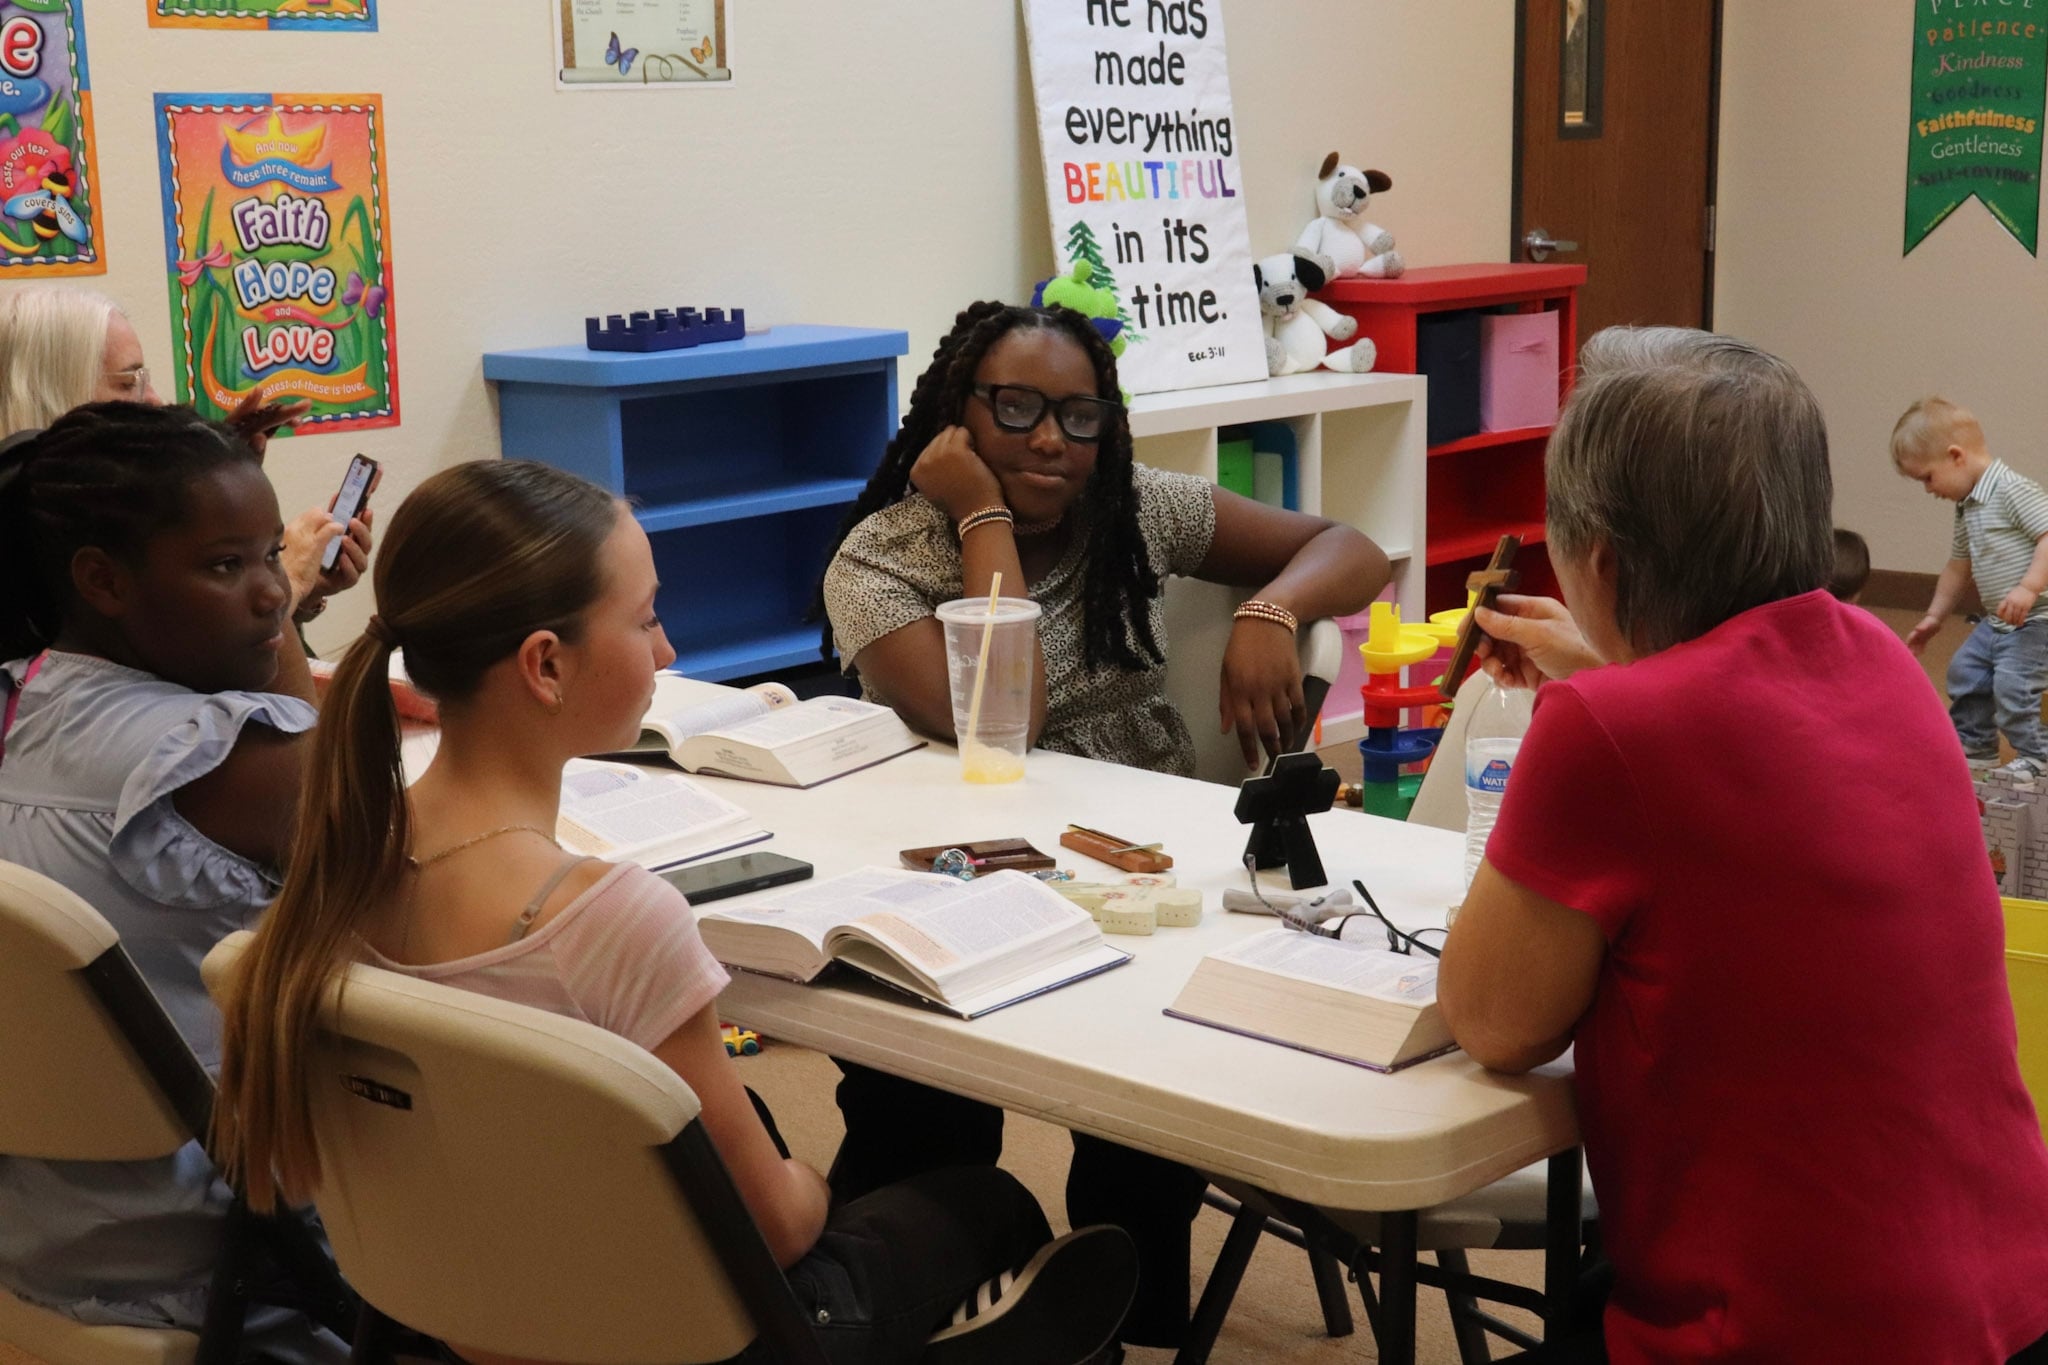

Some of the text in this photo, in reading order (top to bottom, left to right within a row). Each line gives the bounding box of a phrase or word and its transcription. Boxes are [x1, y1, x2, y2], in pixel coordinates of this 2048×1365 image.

[1086, 0, 1208, 39] He has
[1095, 41, 1186, 86] made
[1931, 51, 2024, 76] Kindness
[1065, 105, 1232, 157] everything
[1916, 109, 2036, 138] Faithfulness
[4, 142, 49, 189] casts out fear
[255, 142, 298, 154] And now
[1931, 134, 2023, 159] Gentleness
[232, 163, 327, 187] these three remain:
[1063, 158, 1235, 204] BEAUTIFUL
[24, 199, 75, 225] covers sins
[233, 195, 329, 251] Faith
[1112, 218, 1209, 264] in its
[234, 259, 335, 309] Hope
[274, 307, 291, 317] and
[1131, 283, 1227, 329] time.
[243, 326, 334, 371] Love
[1208, 346, 1225, 359] 3:11
[215, 379, 365, 407] But th eatest of these is love.
